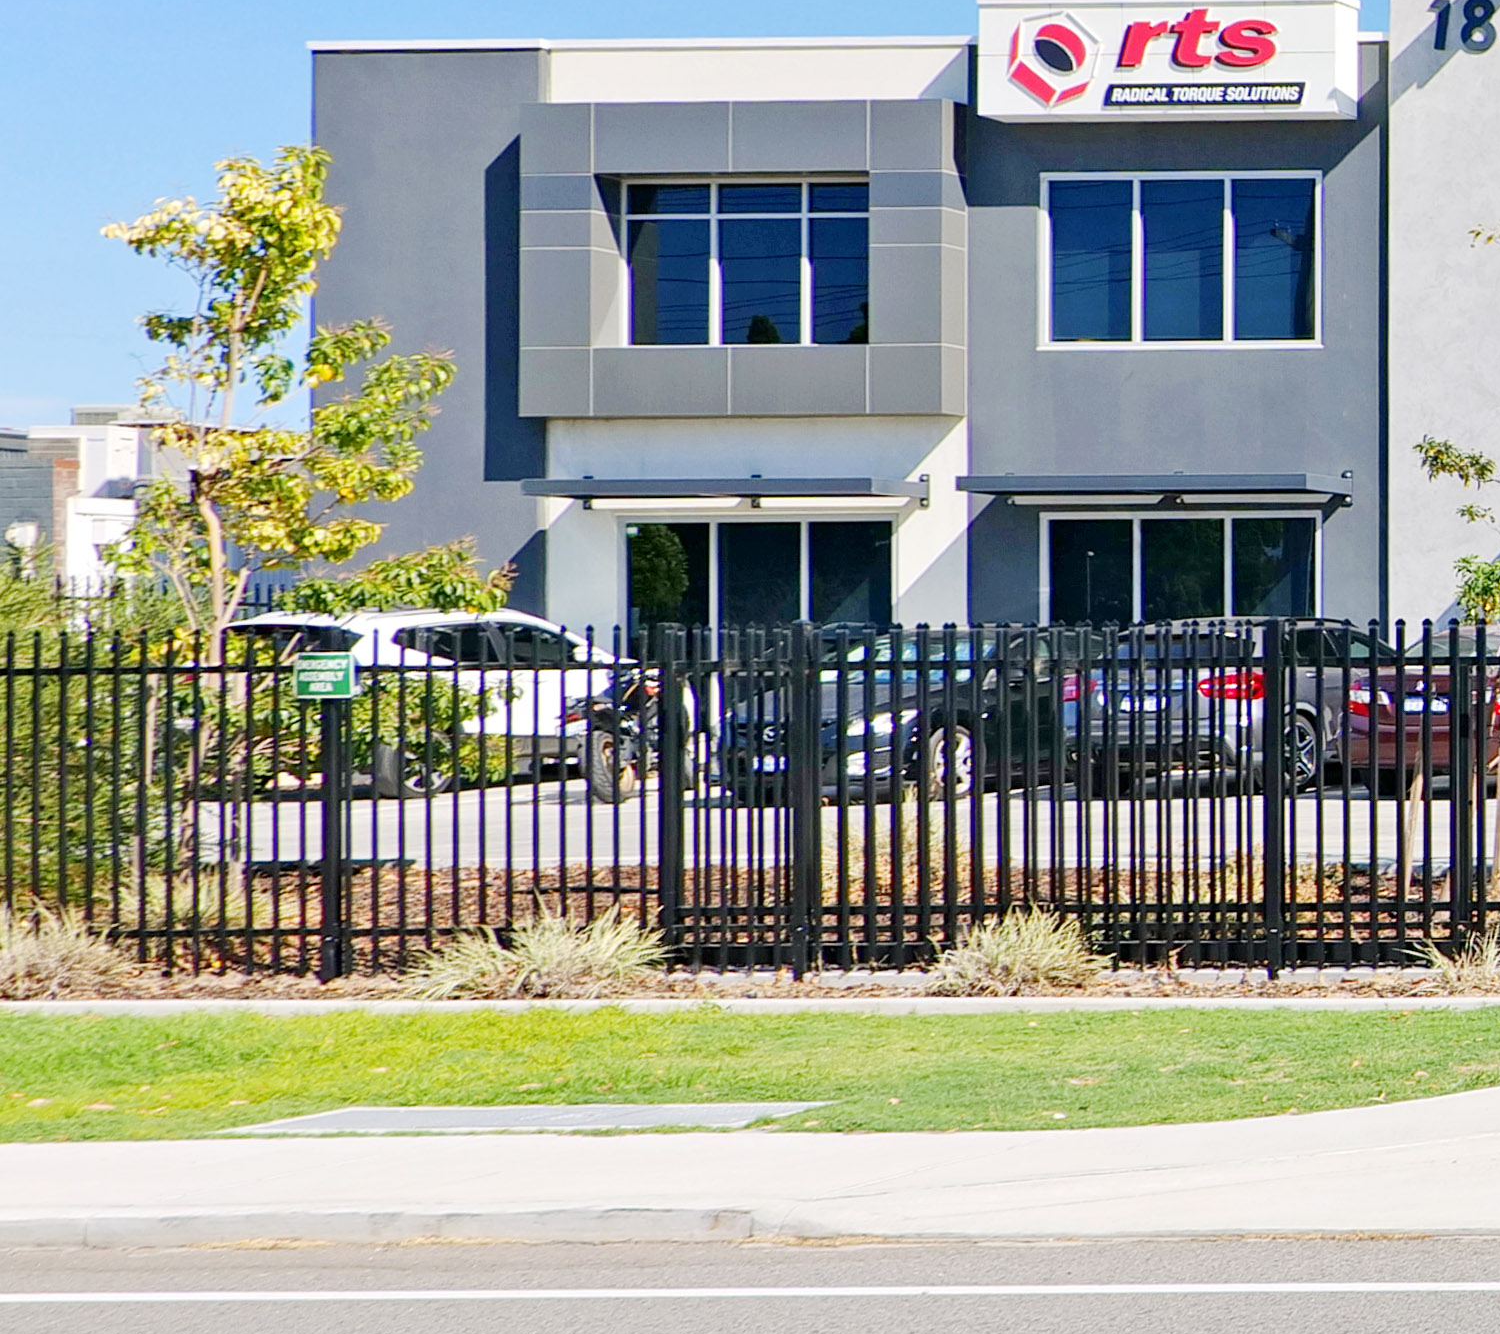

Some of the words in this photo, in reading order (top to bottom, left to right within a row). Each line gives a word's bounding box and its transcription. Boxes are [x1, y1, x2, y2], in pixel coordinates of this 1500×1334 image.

[1115, 8, 1279, 69] rts
[1111, 87, 1169, 102] RADICAL
[1172, 87, 1225, 103] TORQUE
[1225, 86, 1300, 101] SOLUTIONS
